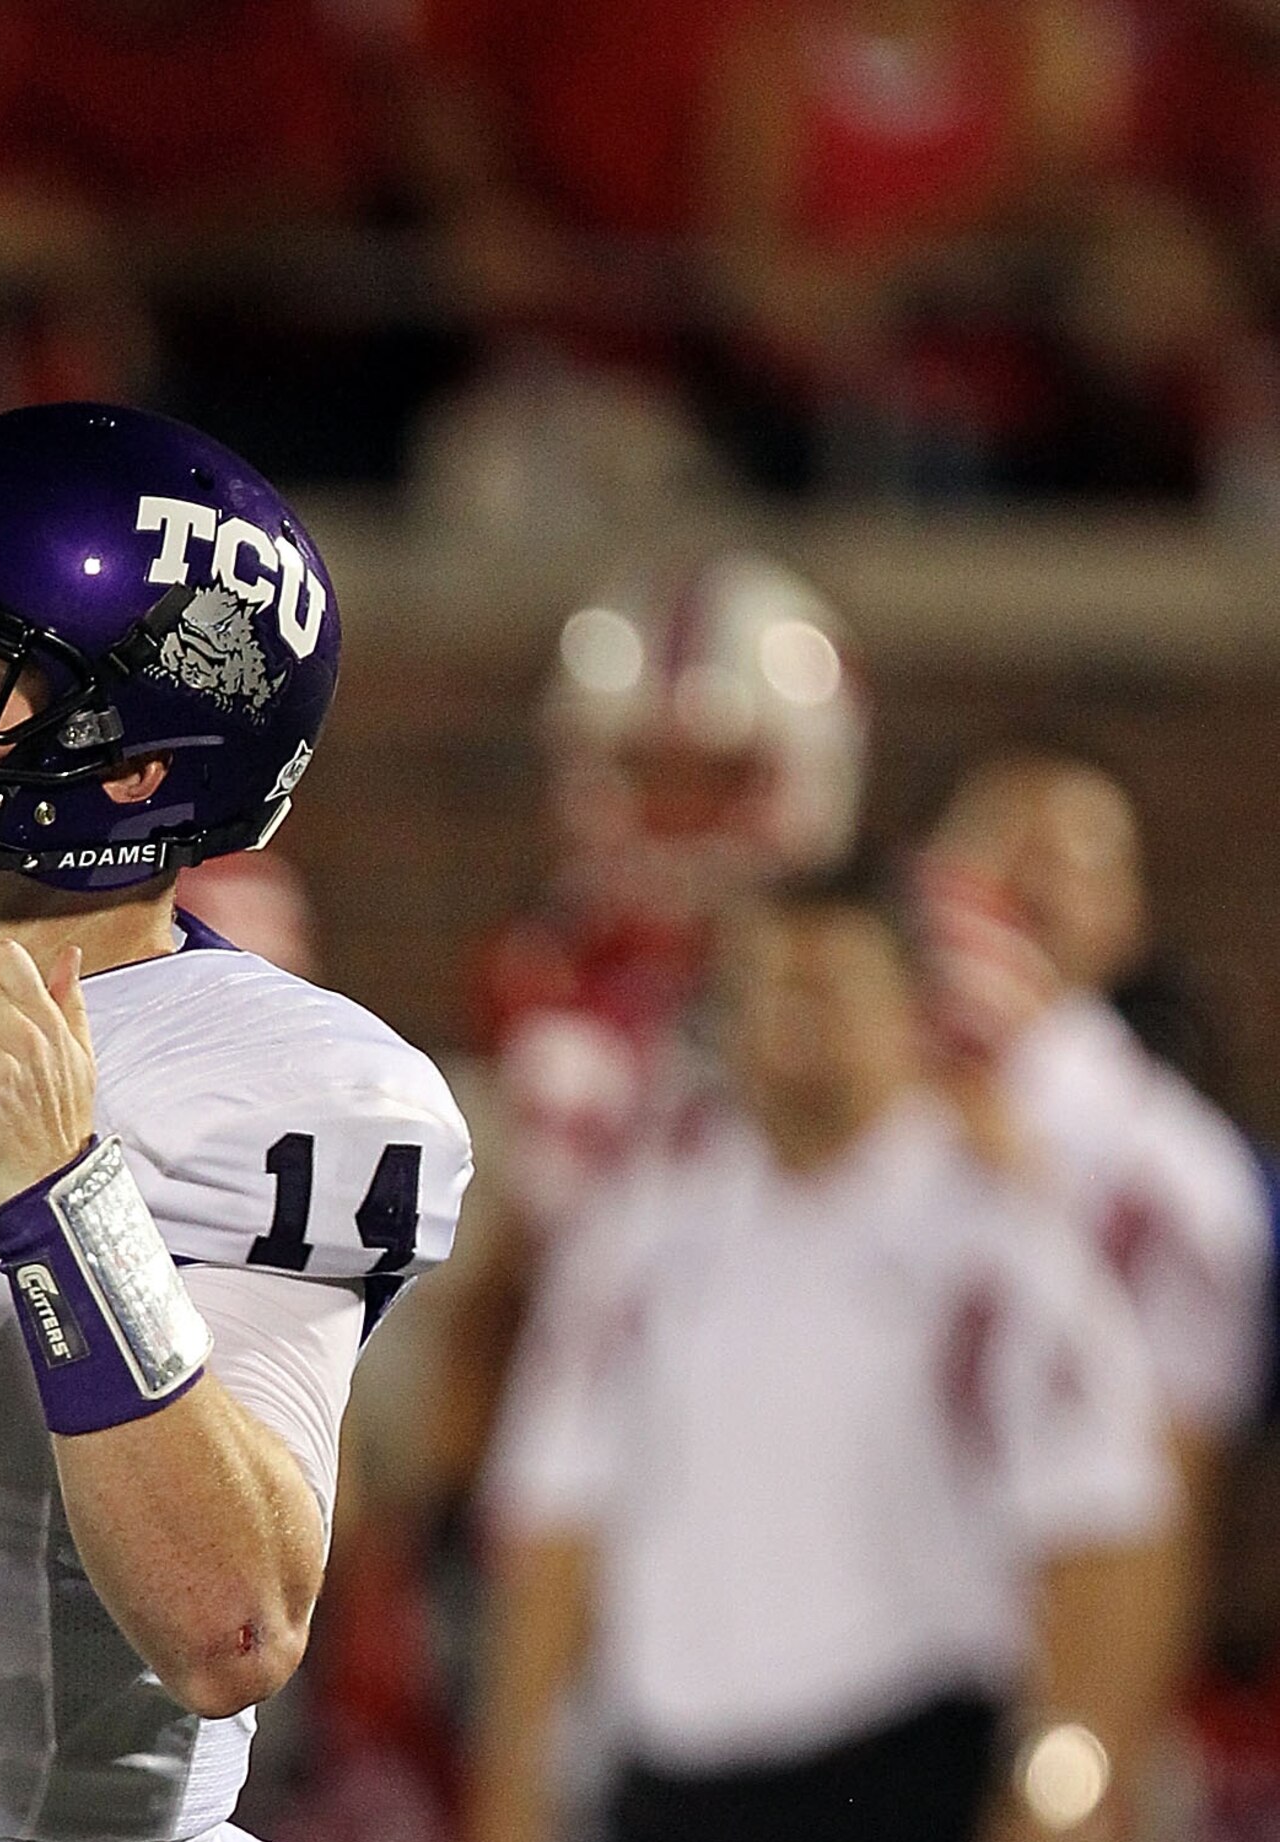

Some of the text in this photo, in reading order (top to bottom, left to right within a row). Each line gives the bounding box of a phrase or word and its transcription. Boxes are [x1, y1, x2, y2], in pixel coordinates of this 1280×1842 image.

[136, 496, 326, 659] TCU
[58, 844, 157, 869] ADAMS
[247, 1132, 423, 1275] 14
[16, 1263, 71, 1359] CUTTERS
